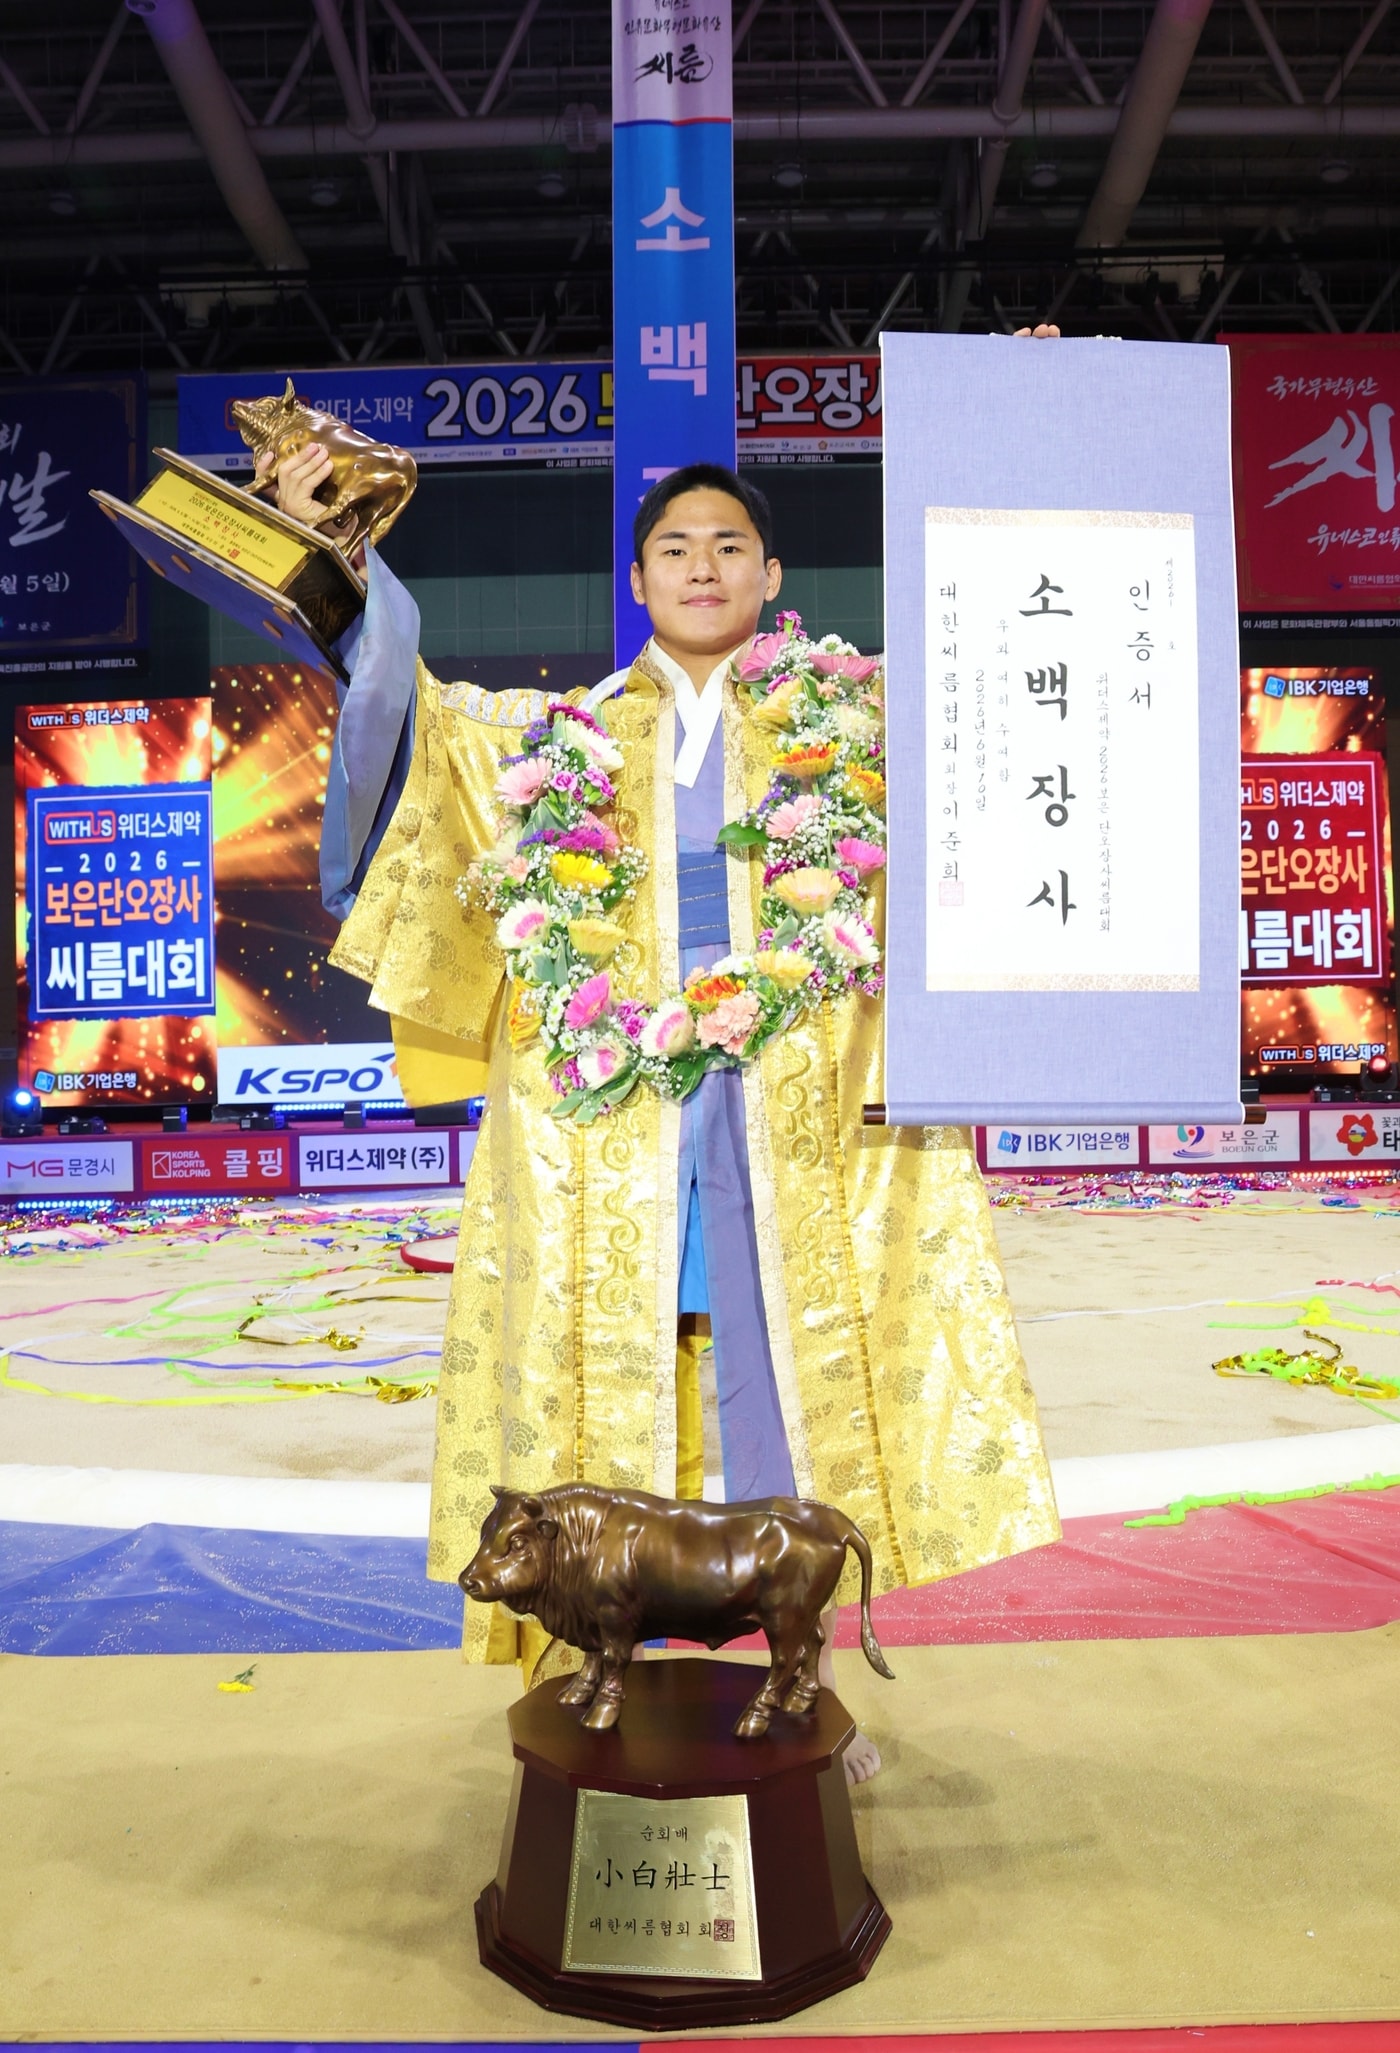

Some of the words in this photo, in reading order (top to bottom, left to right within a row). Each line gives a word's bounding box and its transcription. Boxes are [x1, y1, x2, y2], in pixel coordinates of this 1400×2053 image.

[633, 43, 713, 84] 씨름
[635, 186, 711, 500] 소백
[1267, 375, 1379, 402] 국가무형유산
[424, 377, 587, 436] 2026
[1263, 402, 1400, 513] 씨
[26, 571, 70, 593] 5일)
[1127, 578, 1155, 710] 인증서
[84, 708, 149, 725] 위더스제약
[1018, 573, 1077, 926] 소백장사
[1280, 781, 1365, 806] 위더스제약
[118, 811, 201, 839] 위더스제약
[1241, 819, 1332, 841] 2026
[79, 851, 168, 873] 2026
[45, 875, 203, 927] 보은단오장사
[1241, 908, 1373, 970] 름대회
[46, 937, 205, 1001] 씨름대회
[235, 1067, 384, 1096] KSPO
[1219, 1129, 1280, 1145] 보은군
[1222, 1145, 1255, 1153] BOEUN
[7, 1160, 64, 1178] MG
[68, 1158, 115, 1177] 문경시
[172, 1151, 200, 1160] KOREA
[172, 1160, 205, 1168] SPORTS
[223, 1147, 283, 1178] 콜핑
[172, 1169, 211, 1178] KOLPING
[640, 1825, 688, 1842] 순회배
[595, 1858, 731, 1890] 小白壯士
[589, 1917, 690, 1937] 대한씨름협회
